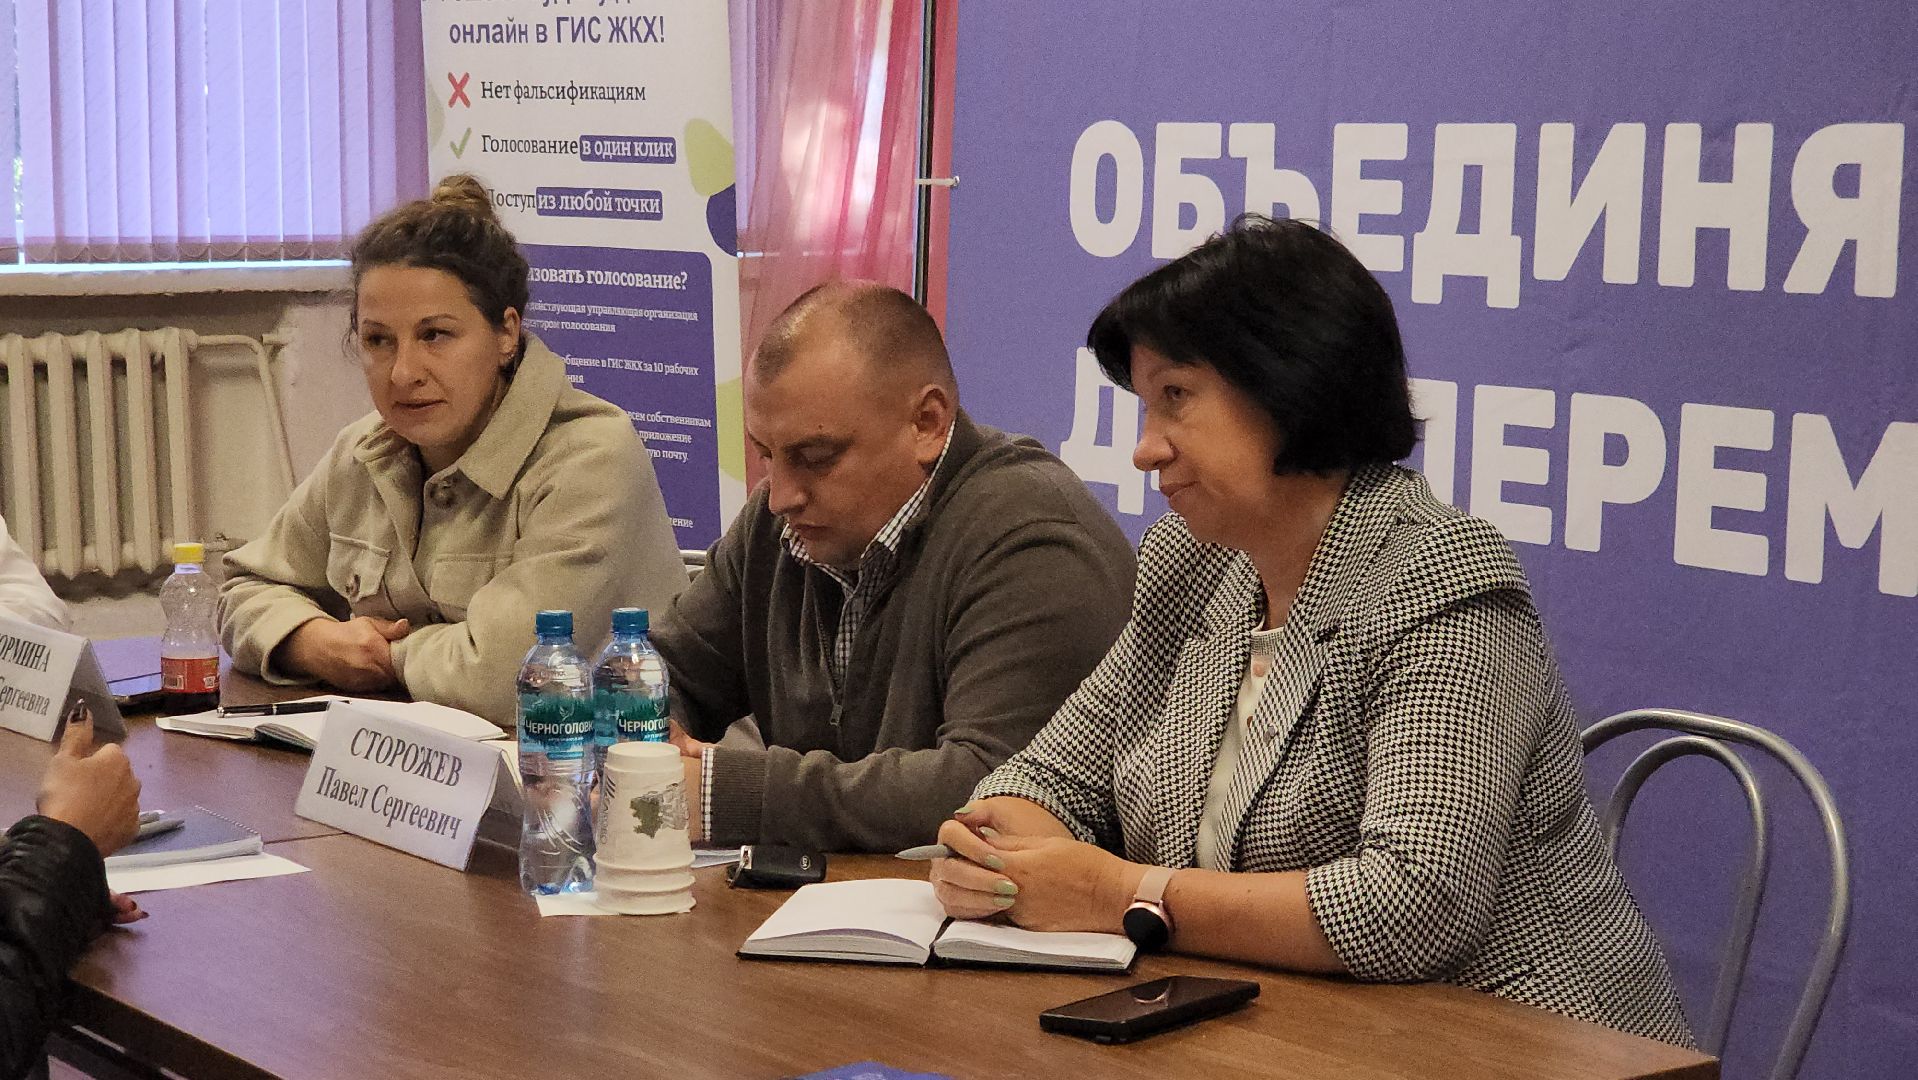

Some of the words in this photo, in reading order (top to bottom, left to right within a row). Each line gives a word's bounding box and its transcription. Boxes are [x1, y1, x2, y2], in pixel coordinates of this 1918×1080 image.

[450, 17, 528, 43] онлайн
[536, 24, 548, 43] в
[556, 16, 601, 43] ГИС
[608, 16, 665, 43] ЖКХ!
[481, 81, 512, 99] Нет
[514, 80, 646, 105] фальсификациям
[481, 135, 579, 154] Голосование
[582, 141, 592, 156] в
[594, 141, 631, 159] один
[634, 143, 674, 158] клик
[538, 194, 556, 210] из
[560, 192, 613, 212] любой
[615, 199, 661, 214] точки
[1069, 120, 1905, 309] ОБЪЕДИНЯ
[586, 270, 688, 290] голосование?
[561, 321, 616, 332] голосования
[607, 357, 624, 369] ГИС
[624, 359, 643, 371] ЖКХ
[643, 363, 653, 372] за
[664, 363, 699, 376] рабочих
[646, 411, 712, 428] собственникам
[350, 727, 463, 787] СТОРОЖЕВ
[316, 766, 369, 809] Павел
[371, 784, 463, 840] Сергеевич
